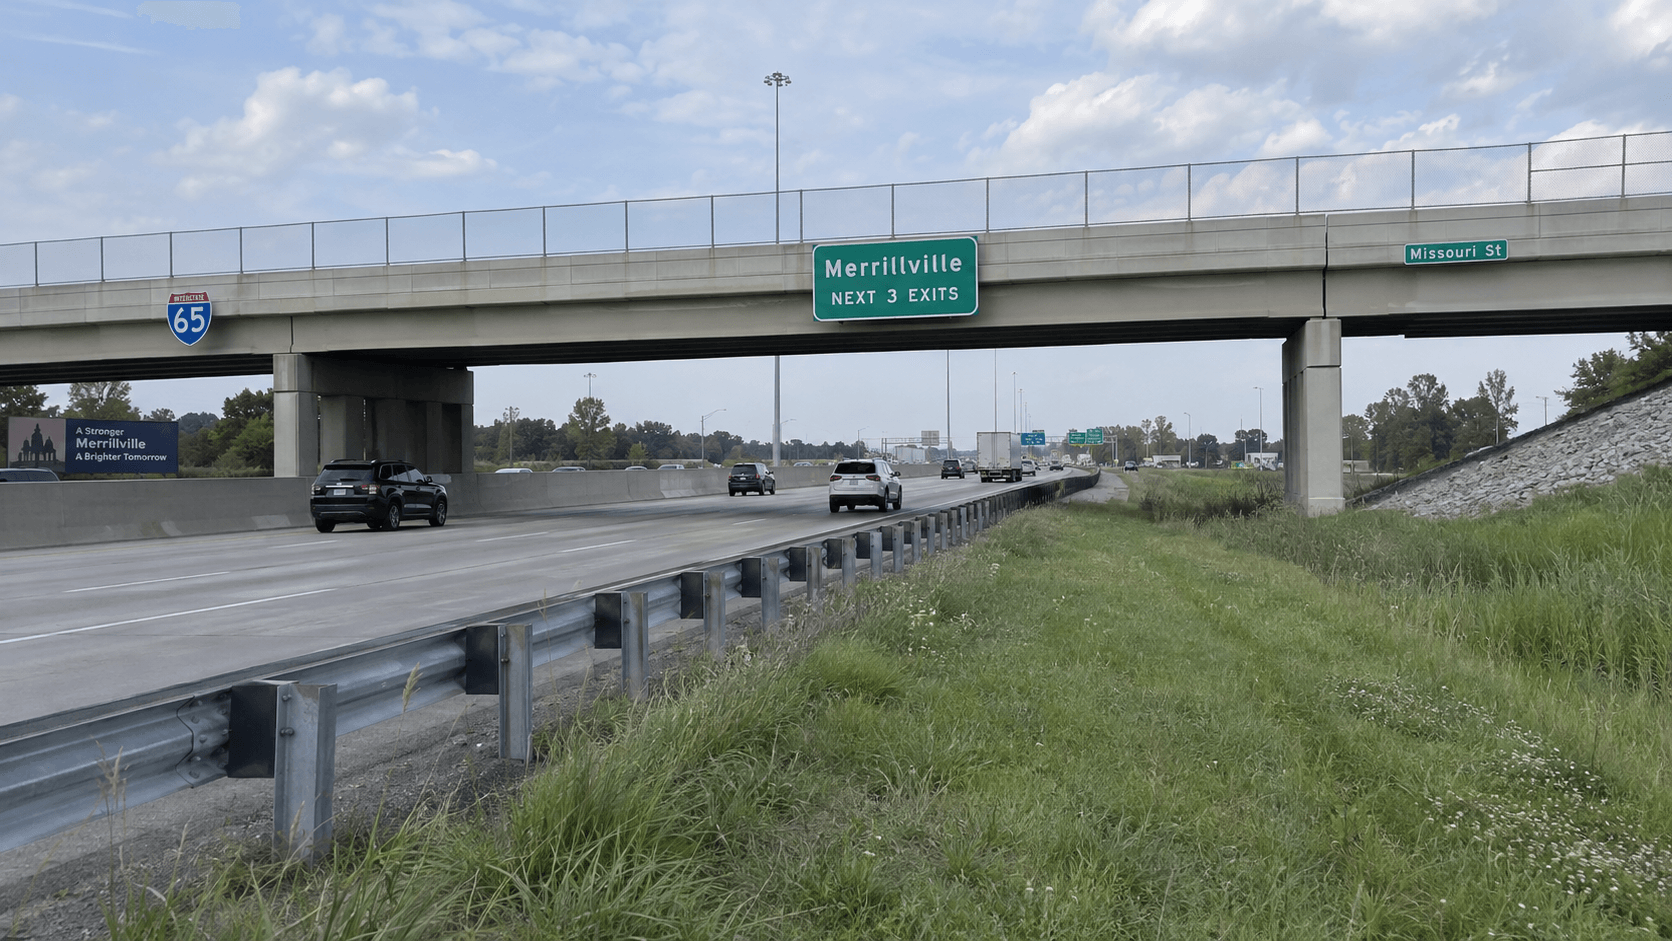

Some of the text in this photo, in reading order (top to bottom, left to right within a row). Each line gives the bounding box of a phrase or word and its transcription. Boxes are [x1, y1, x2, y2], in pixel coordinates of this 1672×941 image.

[1410, 244, 1502, 260] Missouri St
[825, 254, 962, 278] Merrillville
[831, 286, 959, 305] NEXT 3 EXITS
[173, 306, 205, 333] 65
[75, 427, 124, 438] A Stronger
[75, 437, 146, 449] Merrillville
[75, 452, 167, 463] A Brighter Tomorrow
